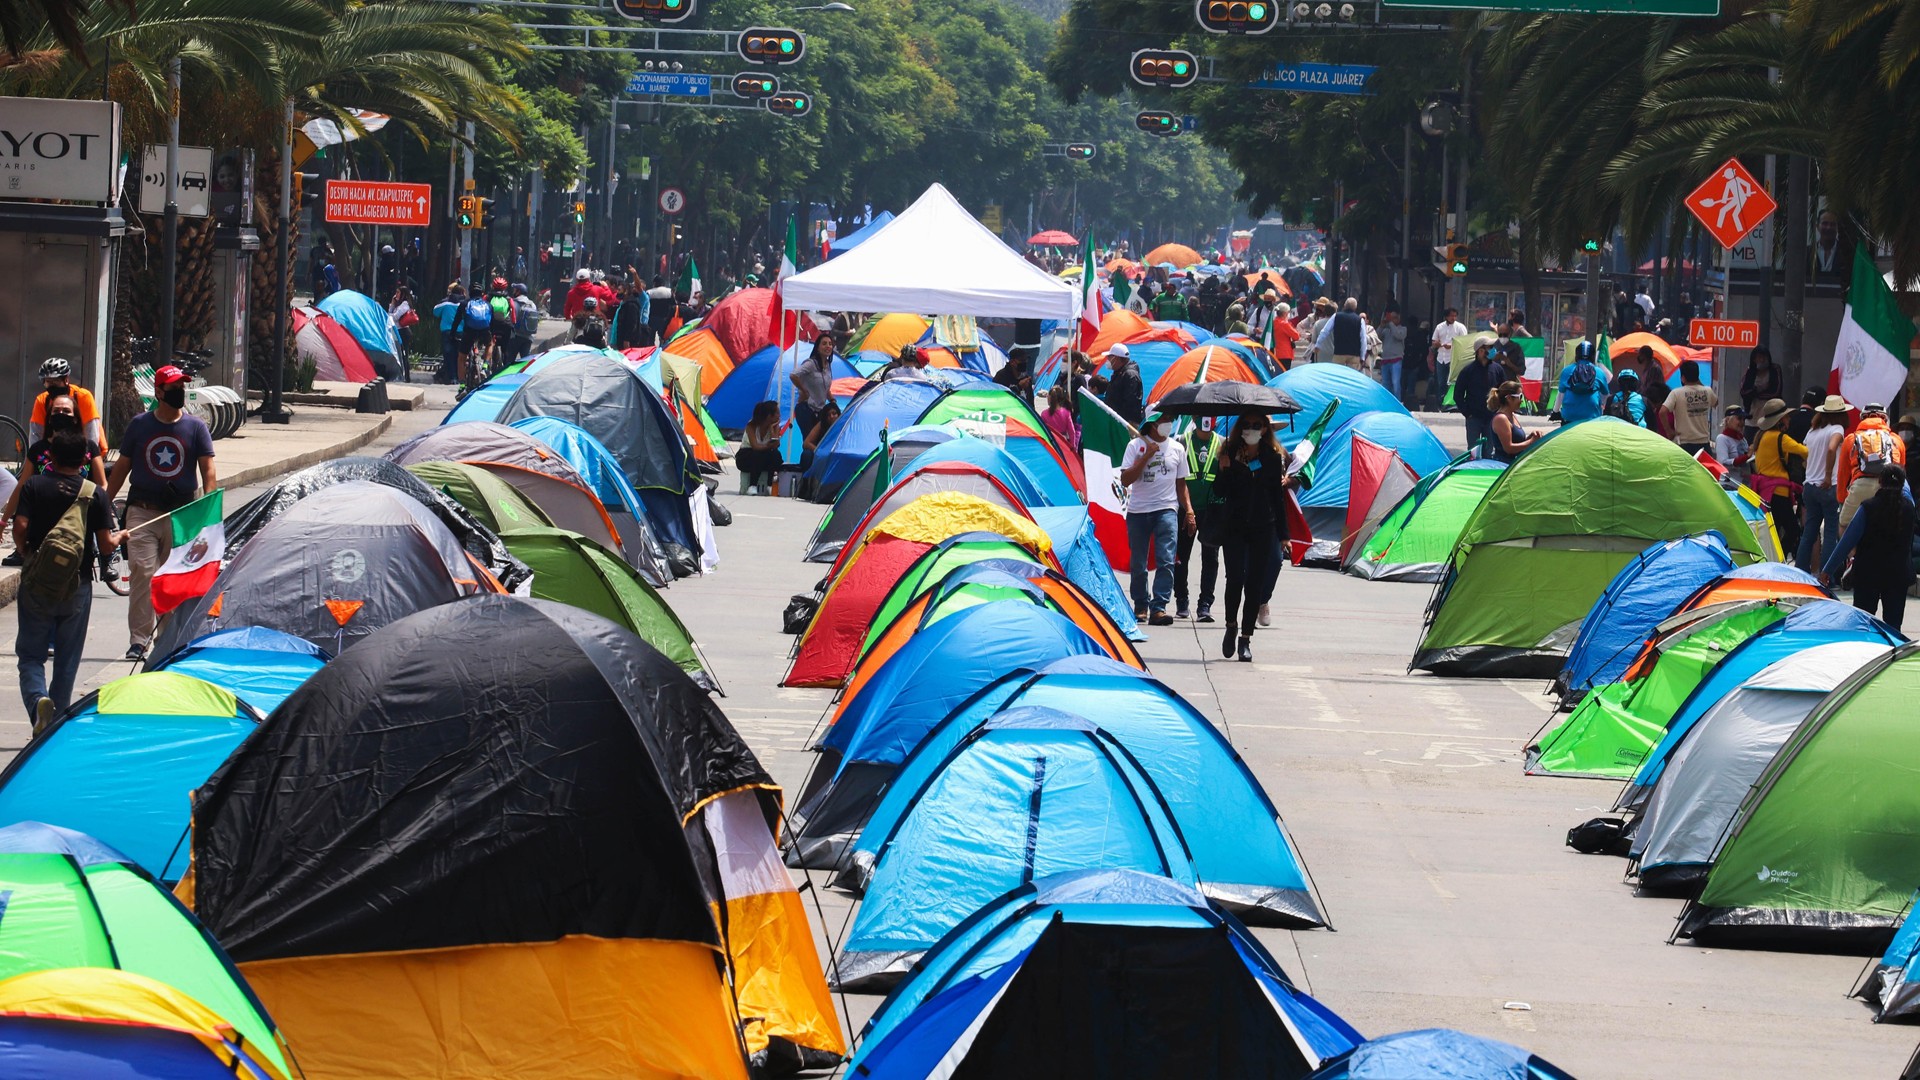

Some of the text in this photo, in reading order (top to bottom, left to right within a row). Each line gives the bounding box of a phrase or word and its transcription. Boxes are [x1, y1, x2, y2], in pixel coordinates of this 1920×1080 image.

[683, 74, 708, 85] PÚBLICO
[1300, 70, 1329, 84] PLAZA
[1331, 69, 1365, 86] JUÁREZ
[648, 83, 671, 93] JUÁREZ
[0, 130, 100, 161] YOT
[0, 163, 36, 171] ARIS
[329, 186, 414, 203] DESVIO HACIA AV. CHAPULTEPEC
[329, 203, 342, 217] POR
[342, 203, 389, 219] REVILLAGIGEDO
[389, 206, 395, 219] A
[396, 206, 406, 219] 100
[1731, 246, 1756, 260] MB
[1695, 325, 1753, 342] A 100 m
[1770, 869, 1799, 878] Outdoor
[1770, 876, 1790, 884] Trend
